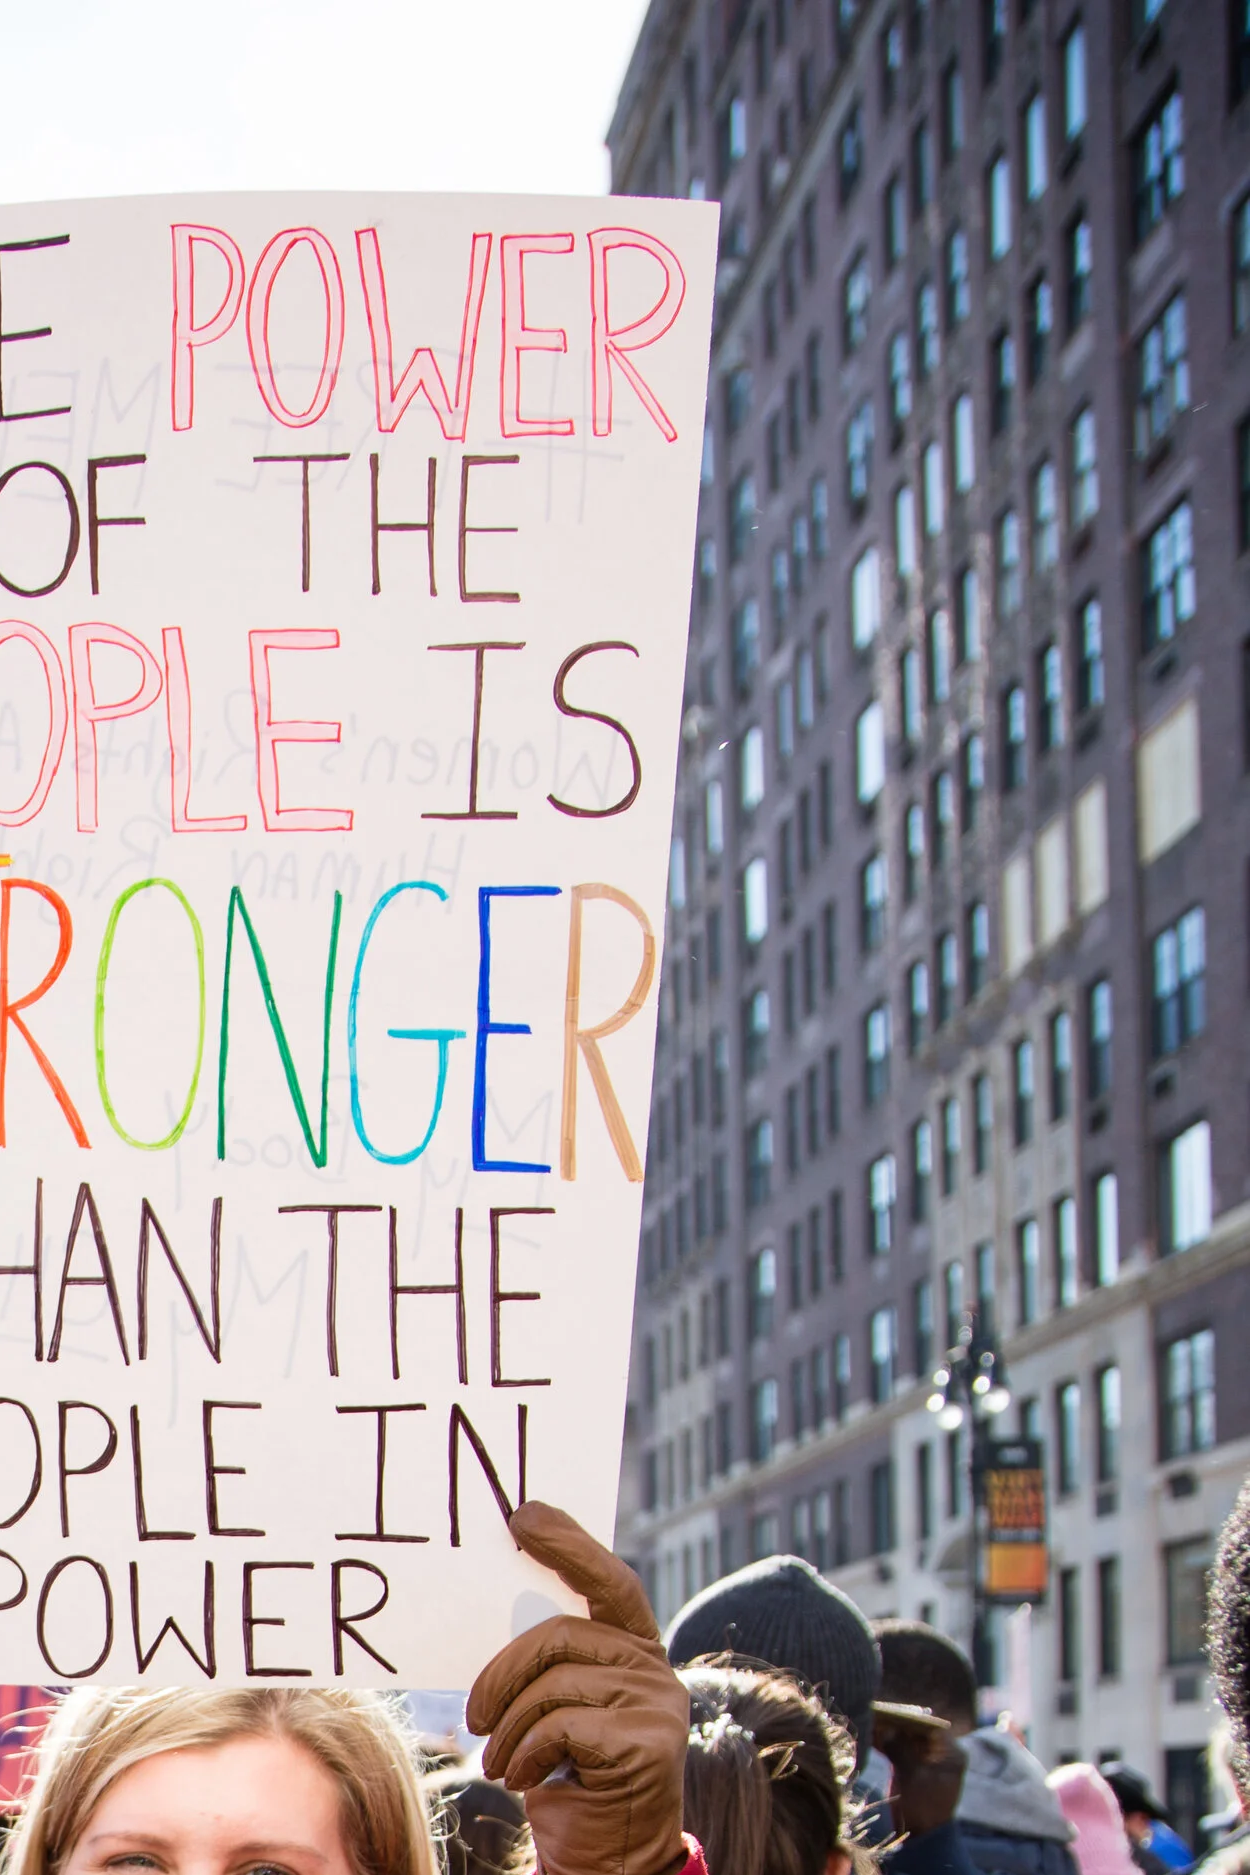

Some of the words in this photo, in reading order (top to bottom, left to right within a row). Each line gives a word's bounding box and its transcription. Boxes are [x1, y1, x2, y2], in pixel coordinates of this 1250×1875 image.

[170, 223, 686, 443] POWER
[253, 453, 521, 603] THE
[421, 641, 642, 820] IS
[278, 1204, 556, 1388] THE
[335, 1403, 529, 1551] IN
